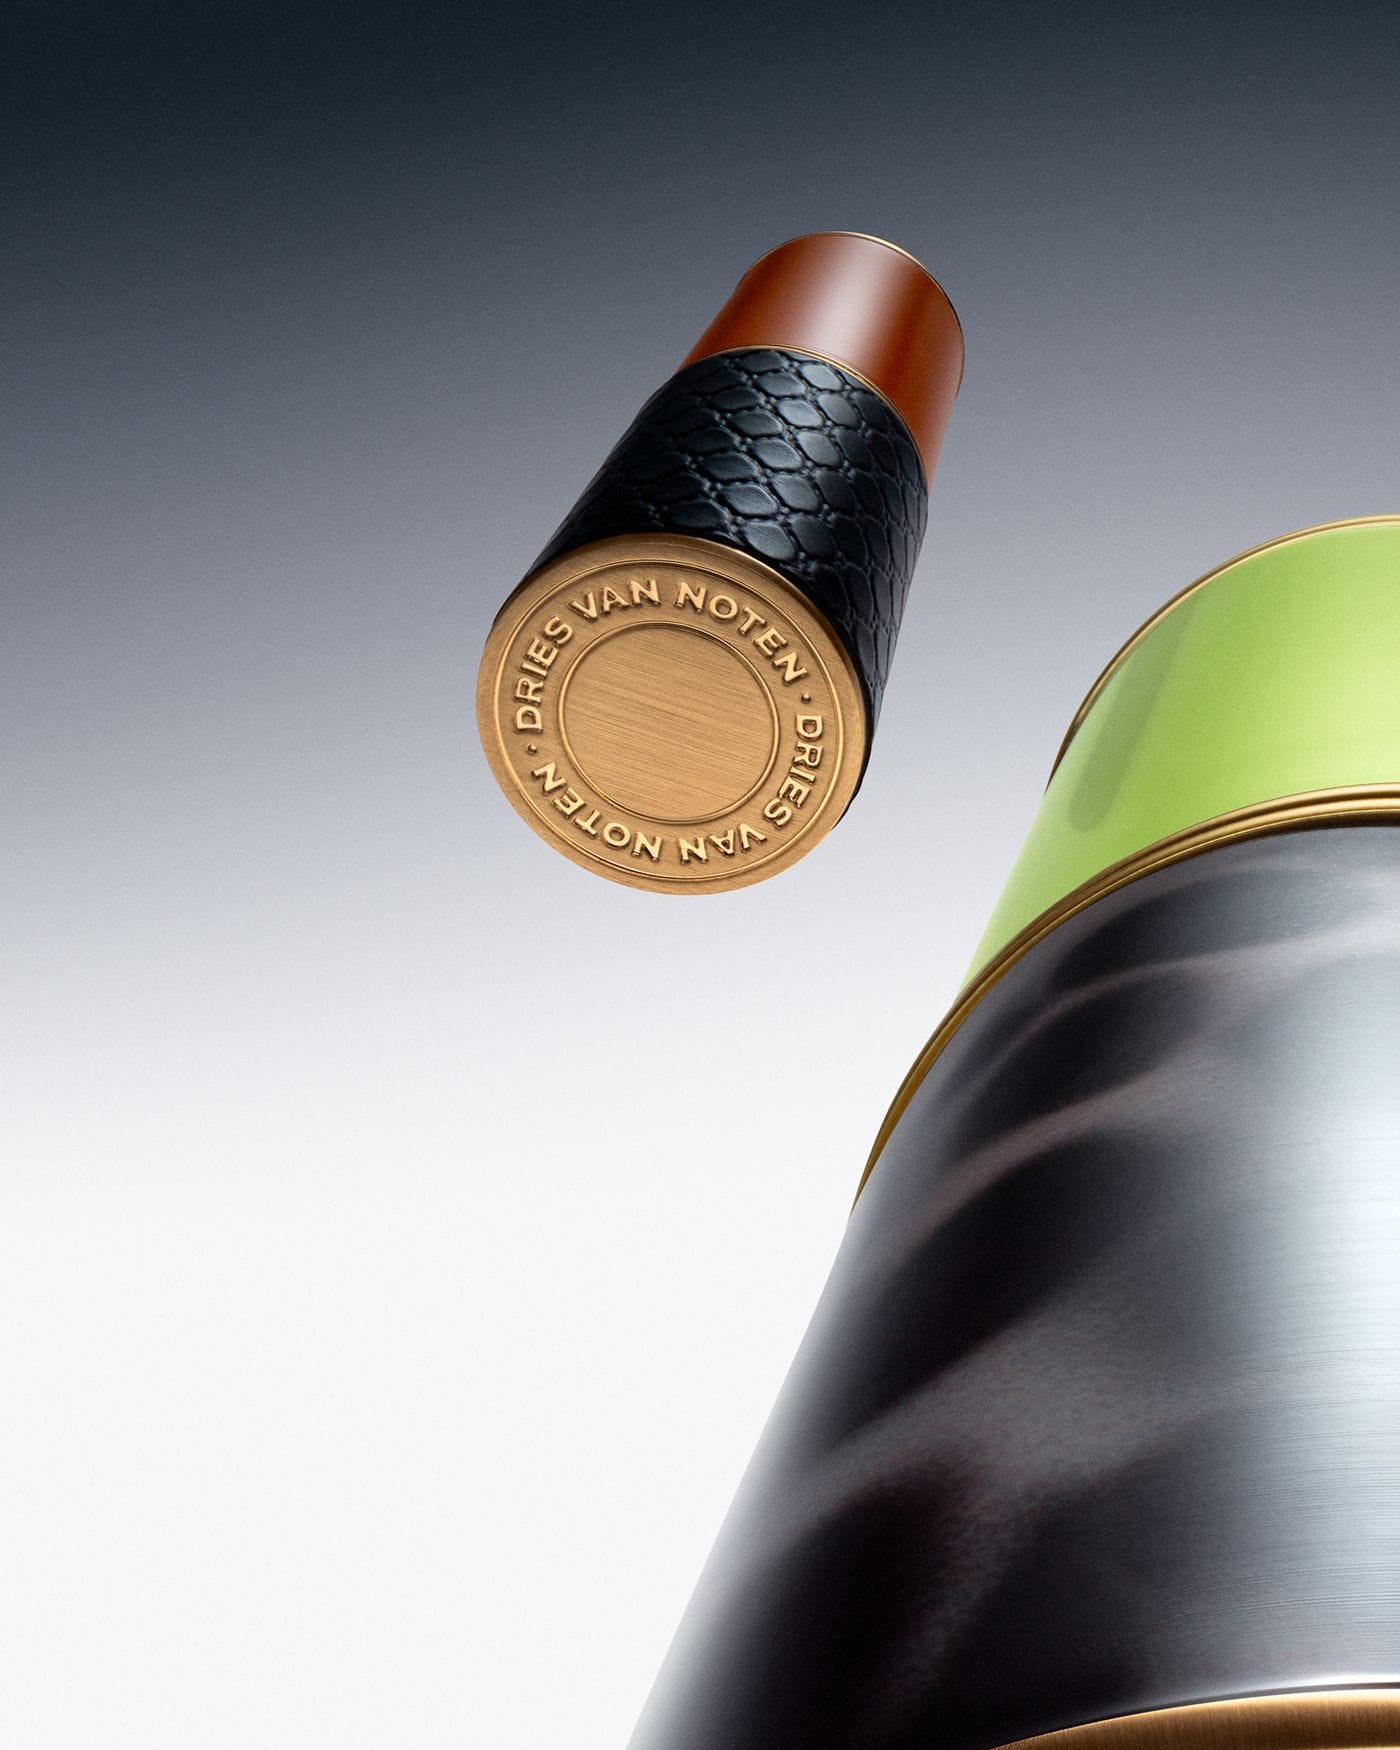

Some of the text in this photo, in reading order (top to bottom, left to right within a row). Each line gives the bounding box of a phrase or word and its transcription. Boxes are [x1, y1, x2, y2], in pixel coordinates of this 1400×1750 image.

[515, 580, 807, 732] DRIES VAN NOTEN
[533, 714, 823, 863] DRIES VAN NOTEN
